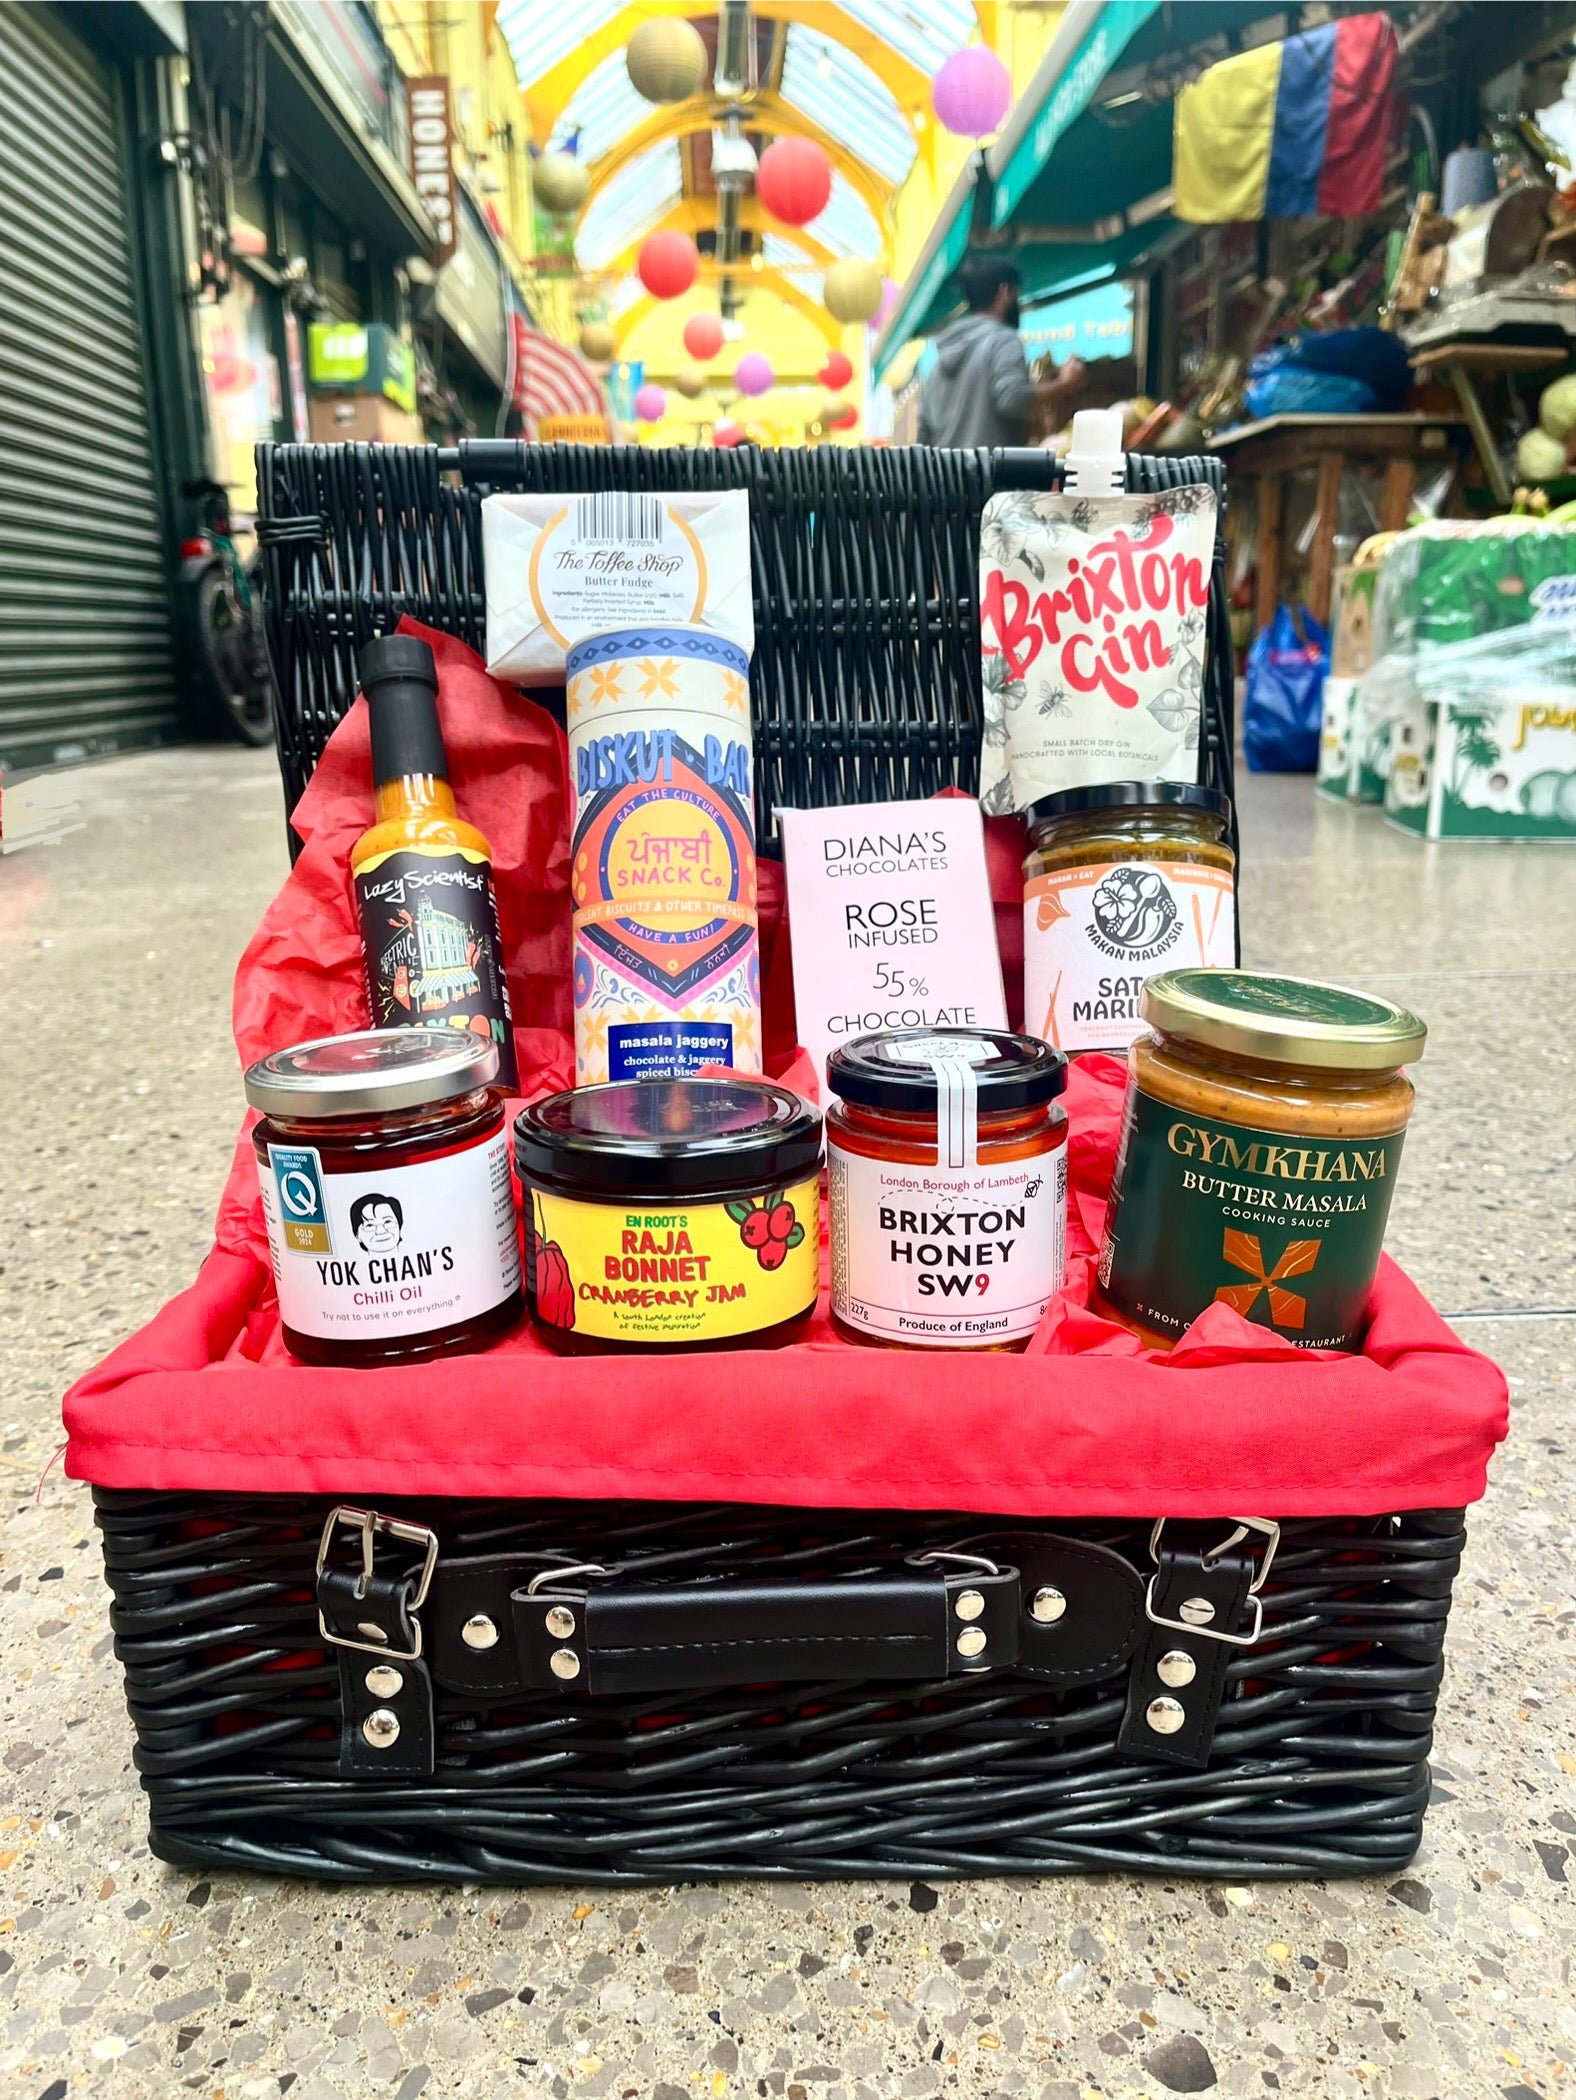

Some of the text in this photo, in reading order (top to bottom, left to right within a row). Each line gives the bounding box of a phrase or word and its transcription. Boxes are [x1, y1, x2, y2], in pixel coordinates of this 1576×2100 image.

[553, 550, 684, 576] The Toffee Shop
[585, 576, 653, 588] Butter Fudge
[981, 514, 1211, 684] Brixton
[1060, 614, 1171, 709] Gin
[1043, 739, 1067, 747] SMALL
[1069, 739, 1095, 747] BATCH
[1099, 739, 1114, 747] DRY
[577, 729, 676, 798] BISKUT
[1011, 749, 1159, 762] HANDCRAFTED WITH LOCAL BOTANICALS
[616, 787, 721, 823] EAT THE CULTURE
[823, 831, 947, 861] DIANA'S
[617, 866, 726, 887] SNACK Co.
[826, 857, 948, 878] CHOCOLATES
[364, 870, 484, 903] Lazy Scientist
[605, 901, 651, 917] BISCUITS
[666, 900, 702, 912] OTHER
[705, 901, 746, 919] TIMEPASS
[845, 899, 938, 930] ROSE
[628, 923, 715, 943] HAVE A FUN!
[848, 928, 939, 949] INFUSED
[1085, 920, 1185, 961] MAKAN MALAYSIA
[873, 962, 929, 997] 55%
[1098, 976, 1143, 998] SAT
[827, 1007, 977, 1034] CHOCOLATE
[1073, 999, 1141, 1022] MARI
[620, 1034, 729, 1050] masala jaggery
[623, 1054, 726, 1067] chocolate & jaggery
[636, 1067, 698, 1079] spiced bisc
[274, 1153, 308, 1163] QUALITY FOOD
[1167, 1122, 1386, 1183] GYMKHANA
[880, 1172, 1029, 1193] London Borough of Lambeth
[1181, 1170, 1368, 1213] BUTTER MASALA
[626, 1214, 688, 1228] EN ROOT'S
[879, 1206, 1025, 1236] BRIXTON
[1222, 1206, 1331, 1228] COOKING SAUCE
[294, 1228, 314, 1238] GOLD
[622, 1230, 694, 1255] RAJA
[890, 1239, 1015, 1267] HONEY
[316, 1246, 454, 1286] YOK CHAN'S
[604, 1255, 711, 1283] BONNET
[353, 1285, 423, 1306] Chilli Oil
[578, 1282, 747, 1308] CRANBERRY JAM
[918, 1273, 990, 1297] SW9
[321, 1311, 334, 1321] Try
[336, 1312, 350, 1321] not
[406, 1299, 453, 1316] everything
[613, 1310, 619, 1320] A
[645, 1313, 672, 1321] London
[675, 1312, 706, 1320] creation
[850, 1302, 869, 1321] 227g
[899, 1317, 946, 1332] Produce
[949, 1320, 961, 1332] of
[965, 1317, 1008, 1333] England
[662, 1322, 701, 1331] inspiration
[1147, 1308, 1179, 1327] FROM
[1291, 1334, 1346, 1349] ESTAURANT
